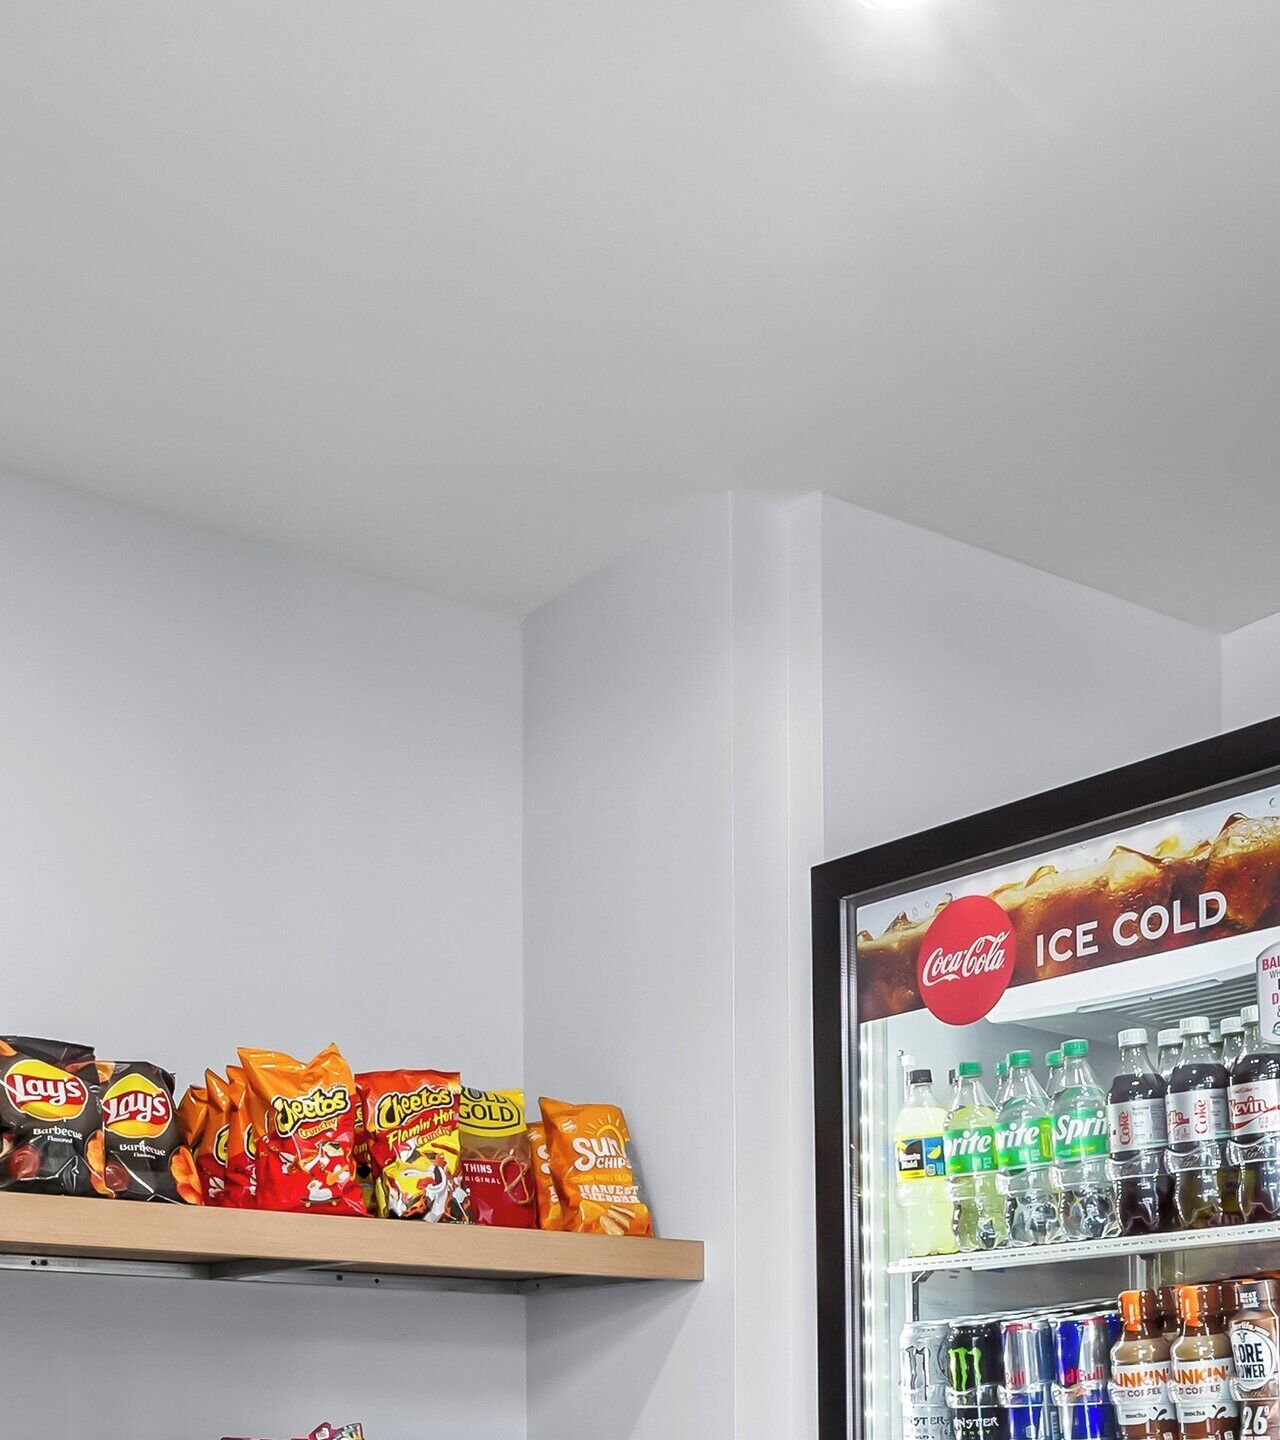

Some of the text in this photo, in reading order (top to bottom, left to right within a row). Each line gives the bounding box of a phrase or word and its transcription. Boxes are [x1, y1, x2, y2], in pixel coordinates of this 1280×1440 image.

[1036, 891, 1227, 967] ICE COLD
[922, 931, 1011, 987] Coca-Cola
[14, 1073, 84, 1106] Lay's
[104, 1091, 168, 1124] Lay's
[273, 1090, 348, 1137] Cheetos
[378, 1088, 452, 1131] Cheetos
[433, 1109, 456, 1125] Hot
[459, 1103, 514, 1122] GOLD
[1195, 1099, 1208, 1134] Coke
[32, 1127, 84, 1142] Barbecue
[298, 1118, 338, 1139] Crunchy
[1057, 1111, 1106, 1145] Spri
[1120, 1111, 1131, 1146] Coke
[119, 1142, 166, 1157] Barbecue
[573, 1136, 628, 1172] Sun
[596, 1157, 633, 1169] CHIPS
[464, 1163, 493, 1174] THINS
[579, 1184, 639, 1195] HARVEST
[1175, 1366, 1229, 1385] UNKIN'
[1125, 1411, 1147, 1419] mocha
